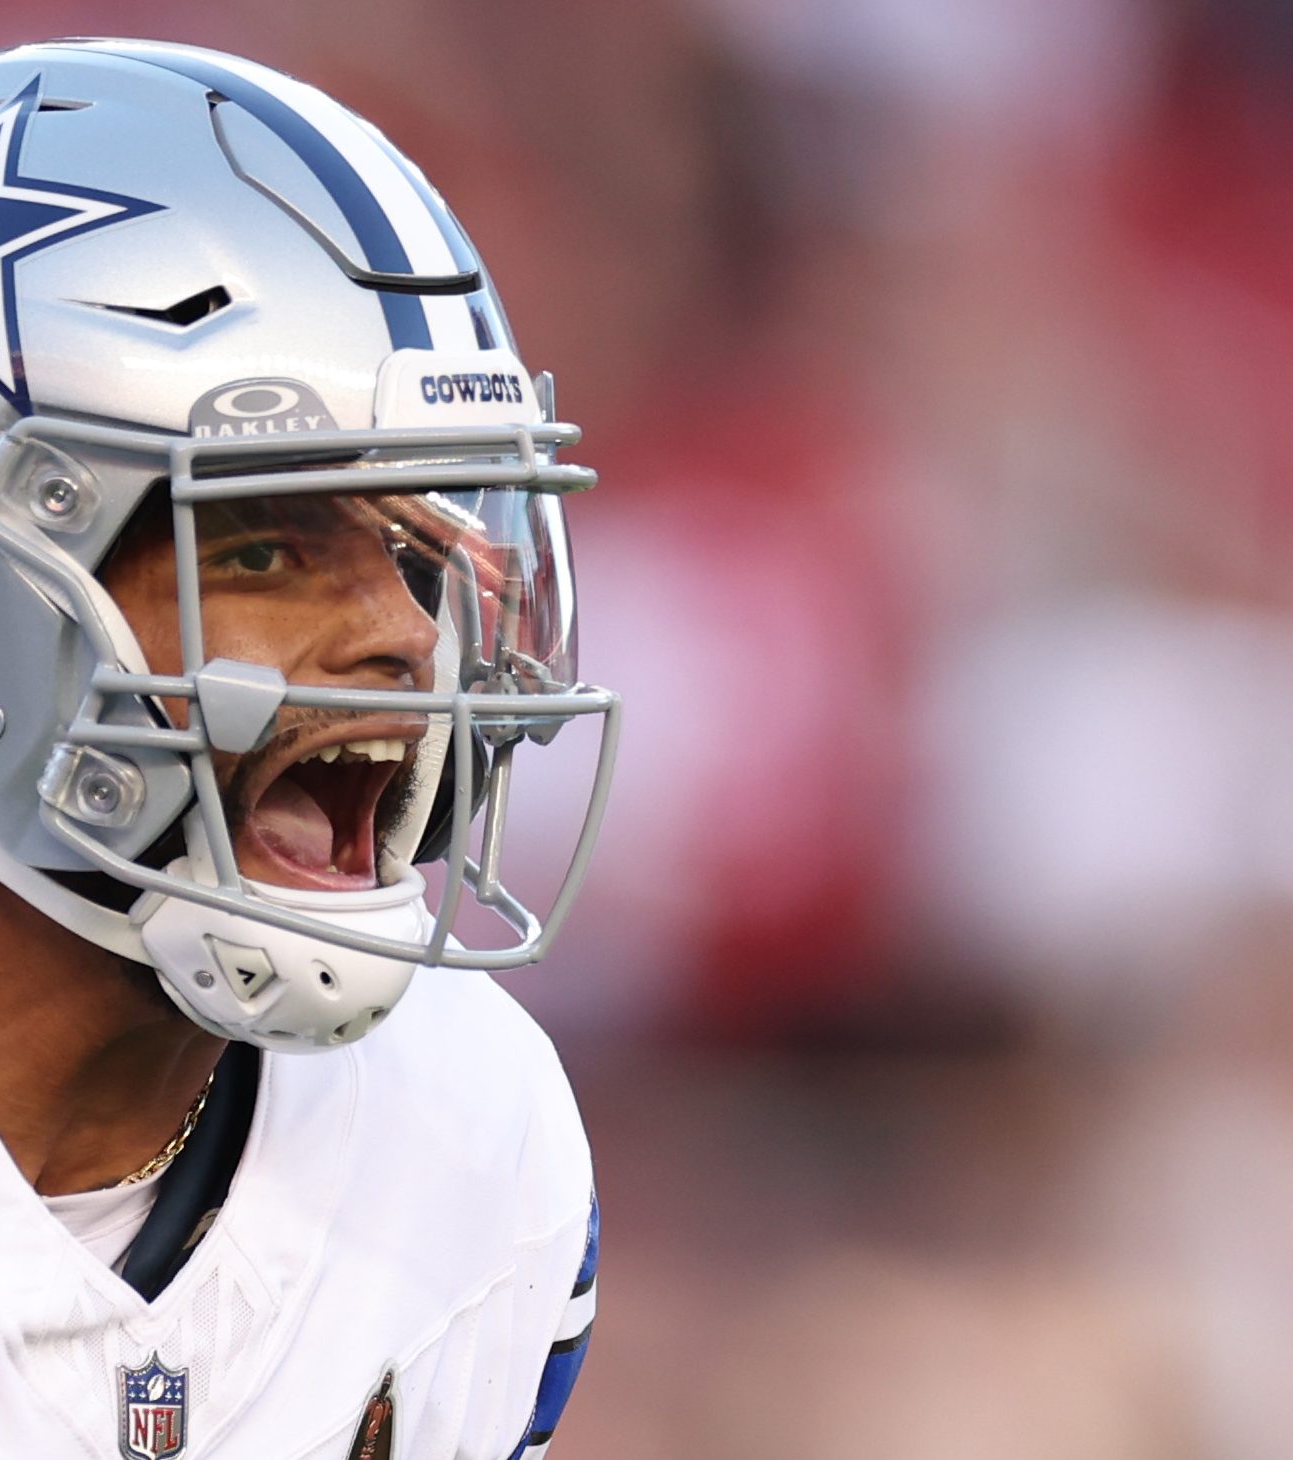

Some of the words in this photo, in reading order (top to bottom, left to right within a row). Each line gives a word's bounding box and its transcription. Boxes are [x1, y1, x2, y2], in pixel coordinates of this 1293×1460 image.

[420, 373, 523, 404] COWBOYS
[195, 416, 321, 438] OAKLEY
[132, 1407, 180, 1453] NFL
